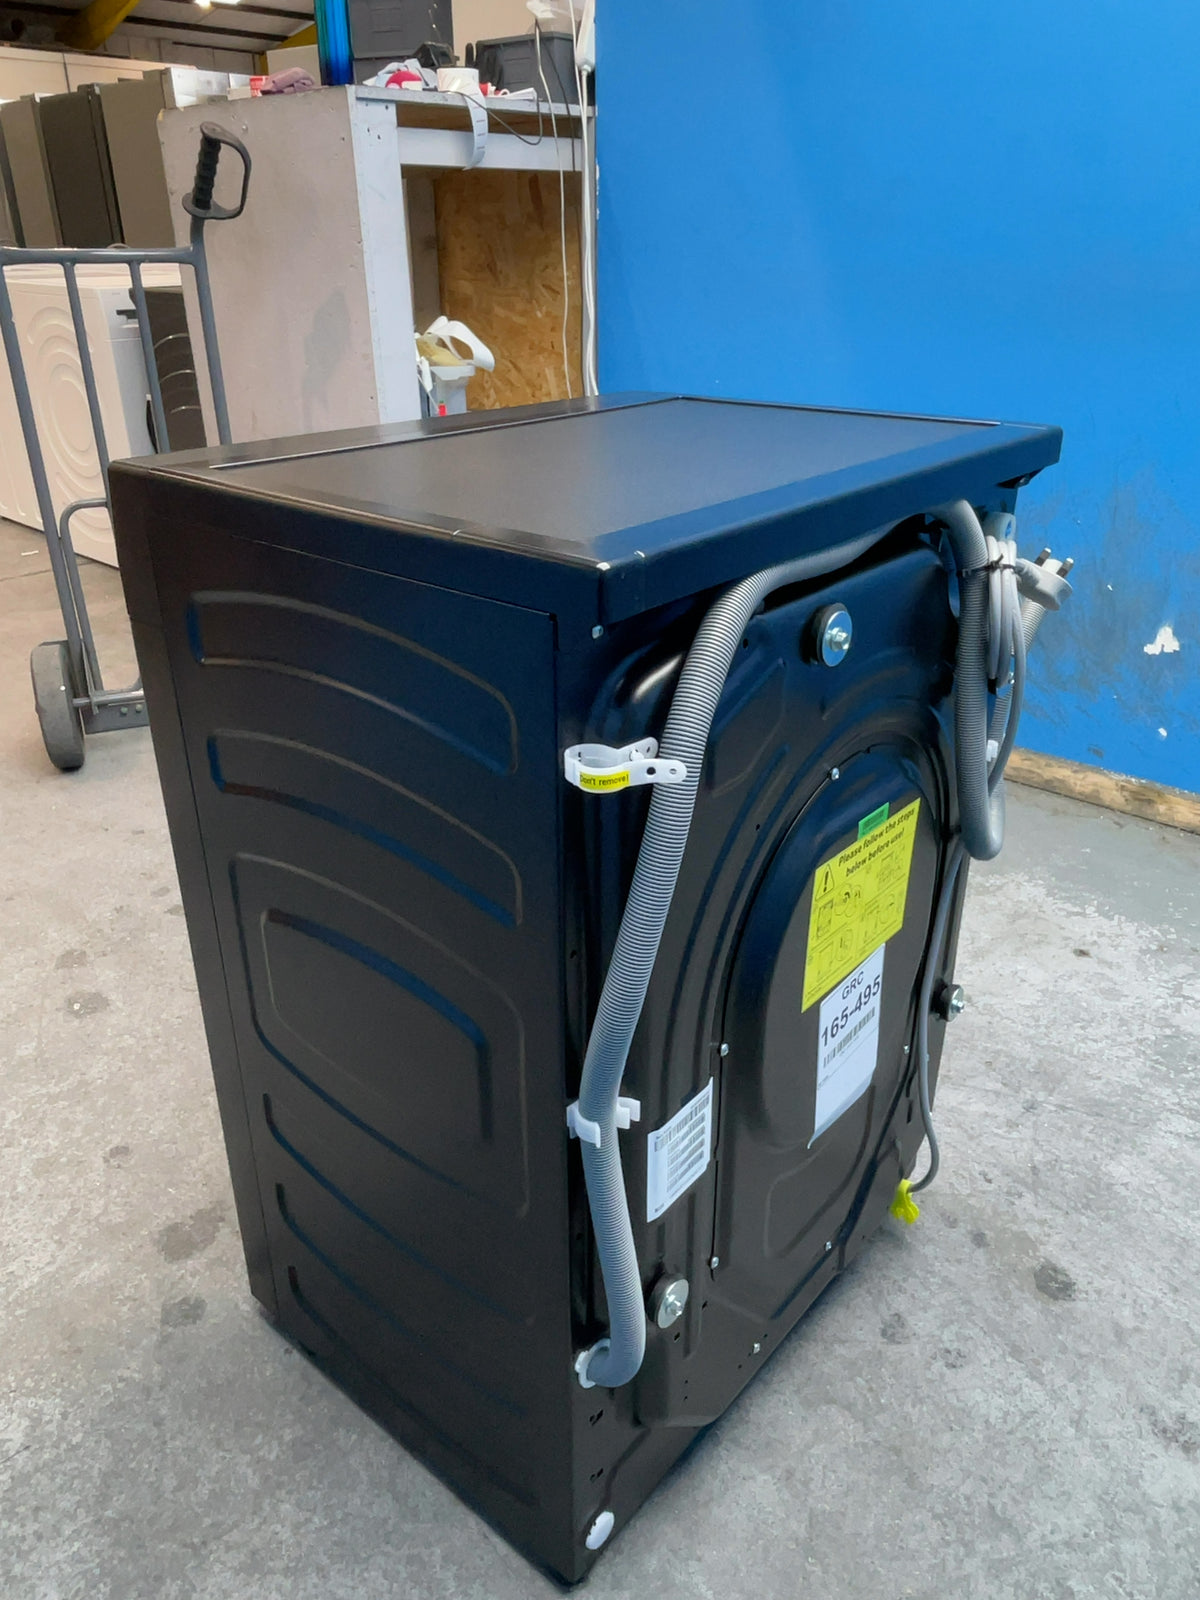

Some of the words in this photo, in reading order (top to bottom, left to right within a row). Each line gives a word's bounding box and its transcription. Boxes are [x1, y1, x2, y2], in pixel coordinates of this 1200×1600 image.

[599, 774, 630, 786] remove!
[838, 845, 862, 867] Please
[863, 829, 884, 850] follow
[884, 819, 896, 834] the
[896, 807, 916, 826] steps
[846, 858, 867, 877] below
[867, 840, 890, 861] before
[841, 971, 864, 1000] GRC
[821, 974, 881, 1047] 165-495
